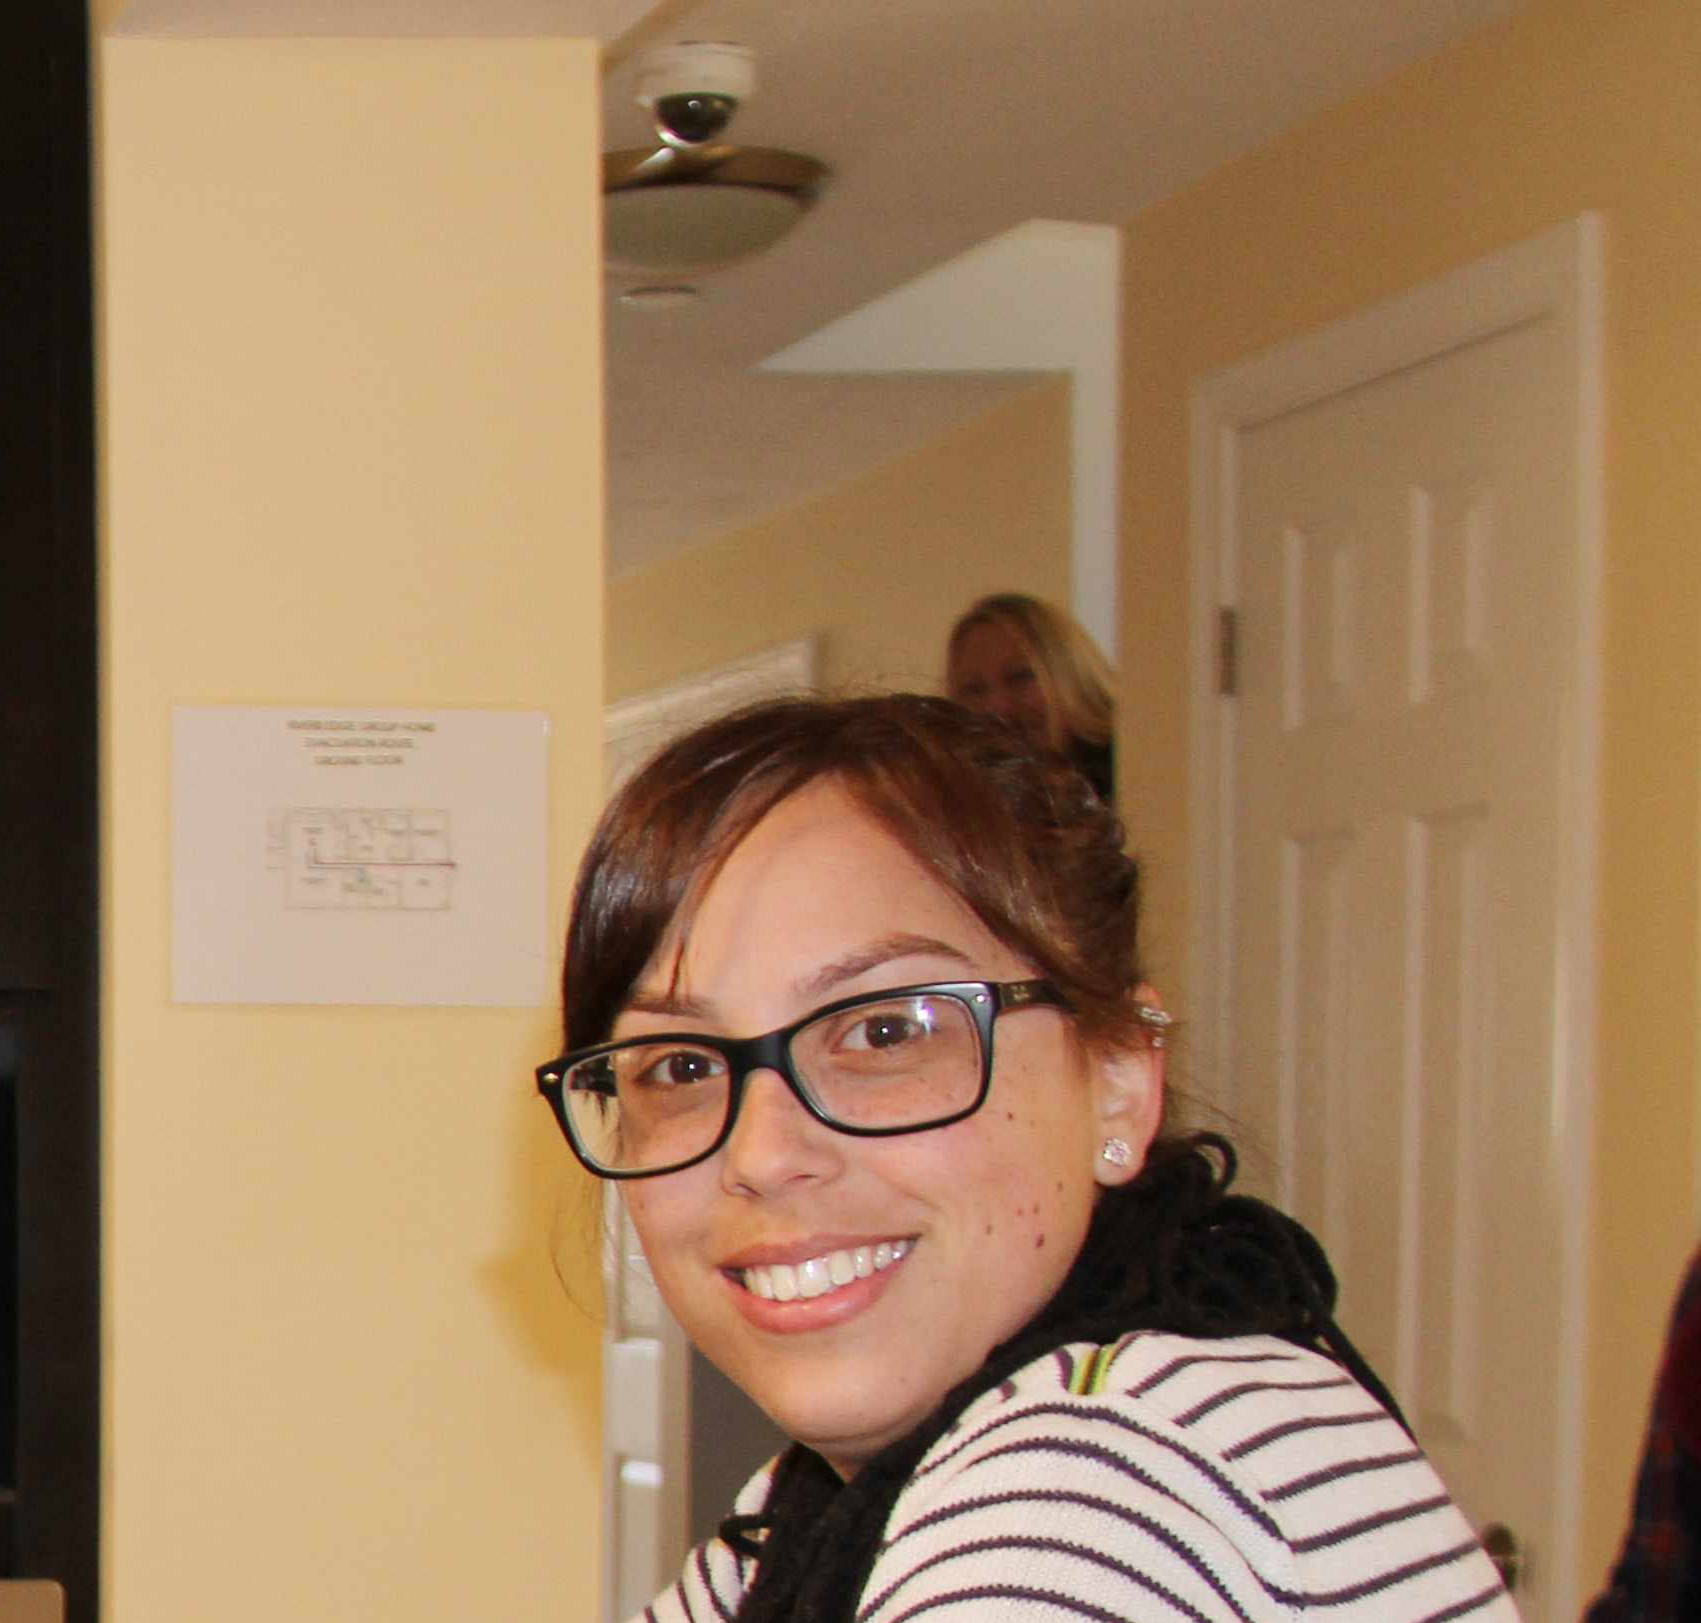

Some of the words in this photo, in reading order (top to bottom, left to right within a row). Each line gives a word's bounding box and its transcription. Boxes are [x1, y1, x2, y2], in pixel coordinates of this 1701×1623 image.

[359, 721, 398, 731] GROUP
[400, 721, 436, 732] HOME
[305, 737, 376, 747] EVACUATION
[314, 755, 362, 765] GROUND
[364, 755, 404, 765] FLOOR
